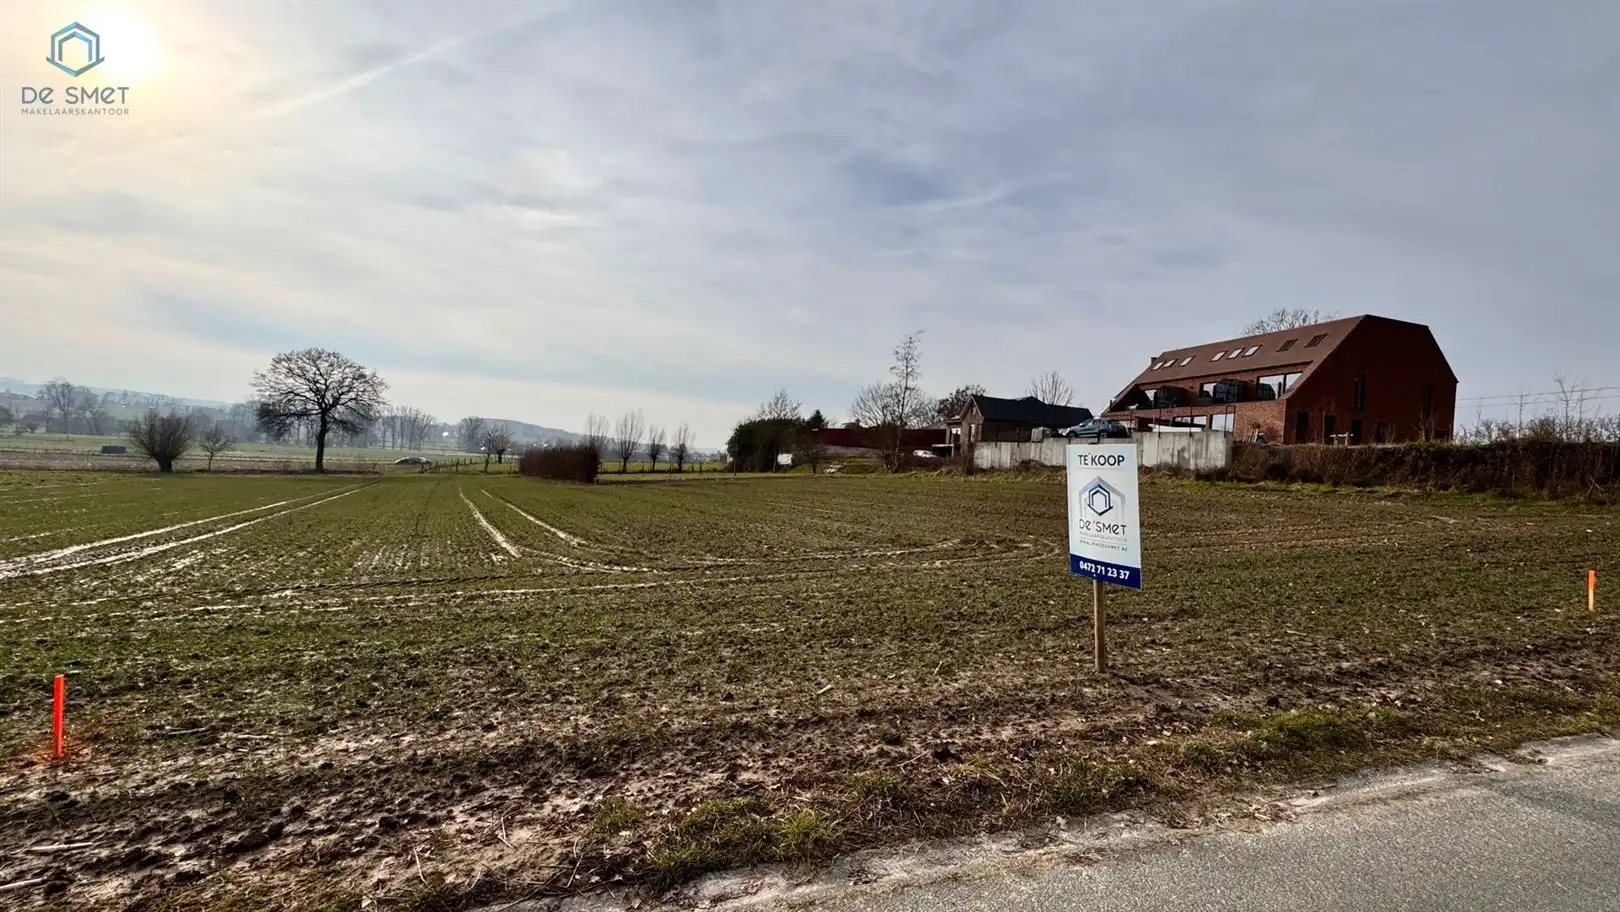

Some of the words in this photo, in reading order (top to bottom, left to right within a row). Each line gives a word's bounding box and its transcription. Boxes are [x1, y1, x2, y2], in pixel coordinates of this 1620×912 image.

[1077, 454, 1089, 466] TE
[1091, 454, 1125, 467] KOOP
[1079, 560, 1096, 573] 0472
[1096, 564, 1106, 576] 71
[1107, 567, 1118, 578] 23
[1119, 569, 1130, 580] 37
